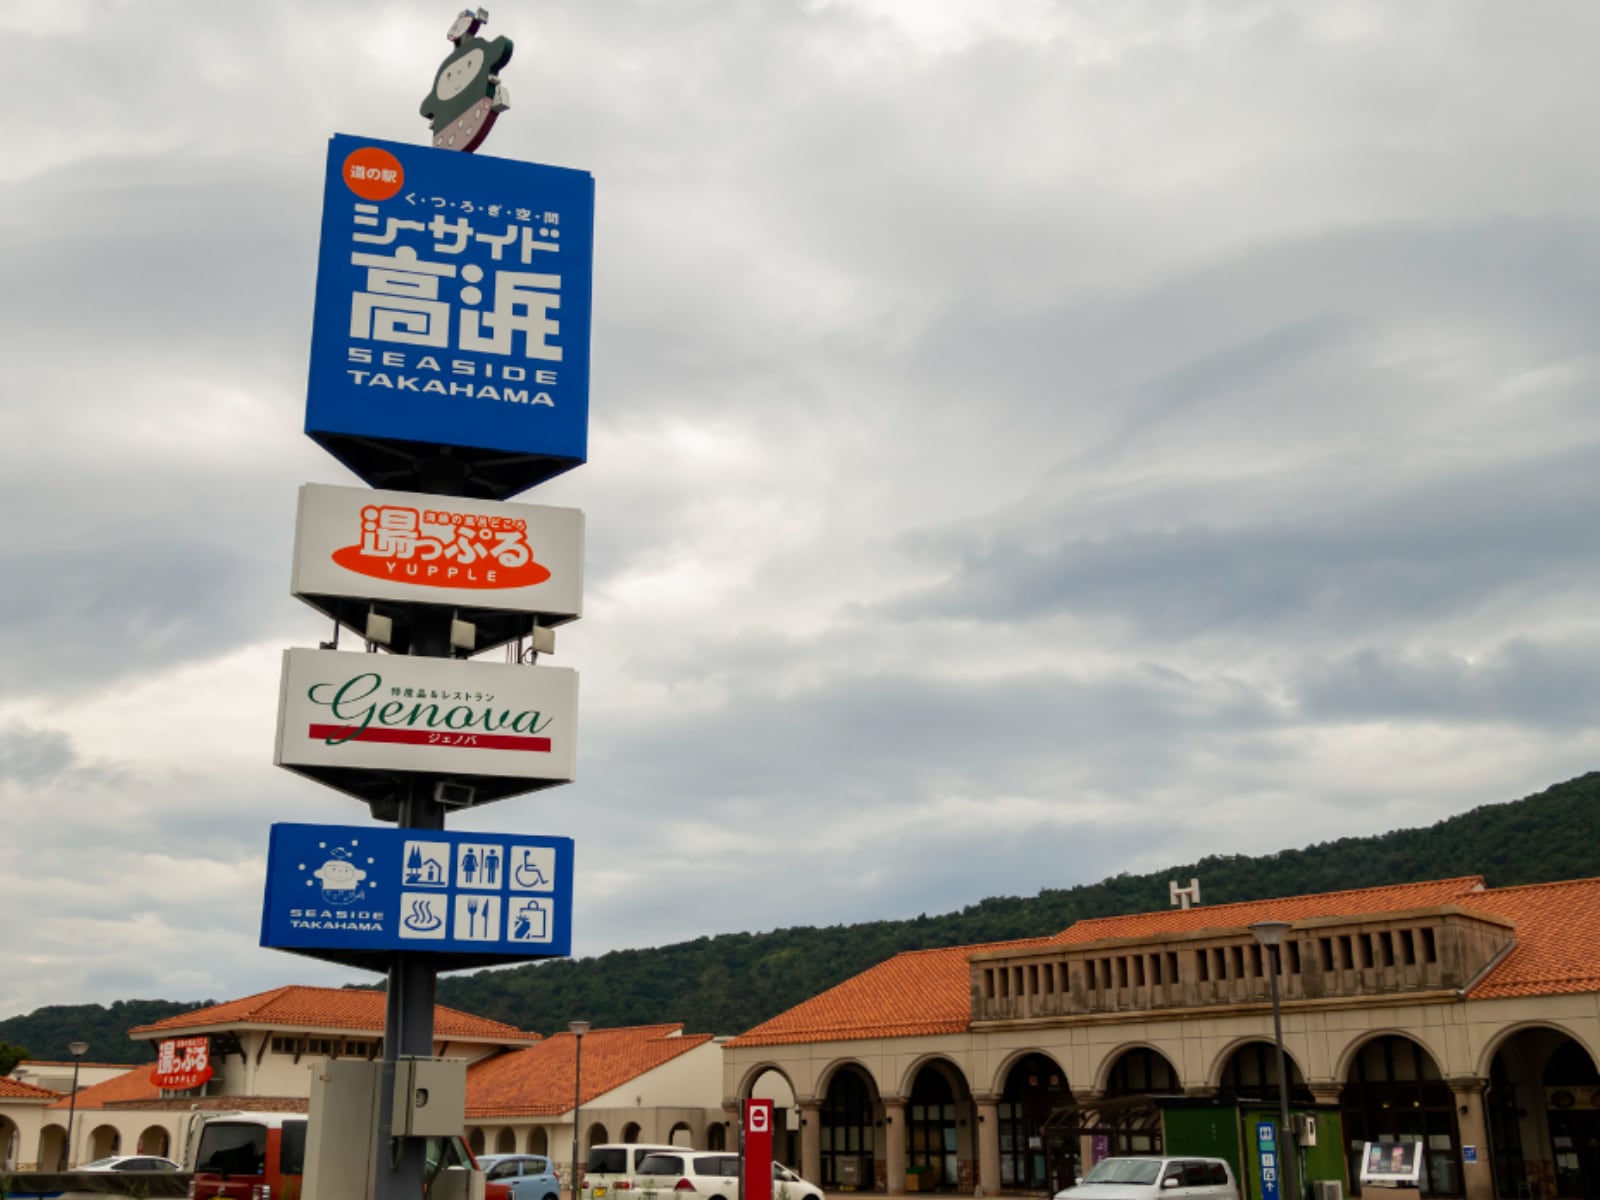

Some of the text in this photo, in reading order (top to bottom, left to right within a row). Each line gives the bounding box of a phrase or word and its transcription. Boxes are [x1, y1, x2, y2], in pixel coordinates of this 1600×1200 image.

[350, 165, 398, 184] 道の駅
[352, 203, 560, 265] シーサイド
[350, 246, 563, 362] 高浜
[348, 347, 558, 385] SEASIDE
[347, 369, 555, 407] TAKAHAMA
[360, 506, 532, 568] 湯っぷる
[386, 561, 497, 582] YUPPLE
[307, 673, 553, 746] Genova
[428, 732, 478, 746] ジェノバ
[289, 908, 384, 921] SEASIDE
[290, 920, 383, 932] TAKAHAMA
